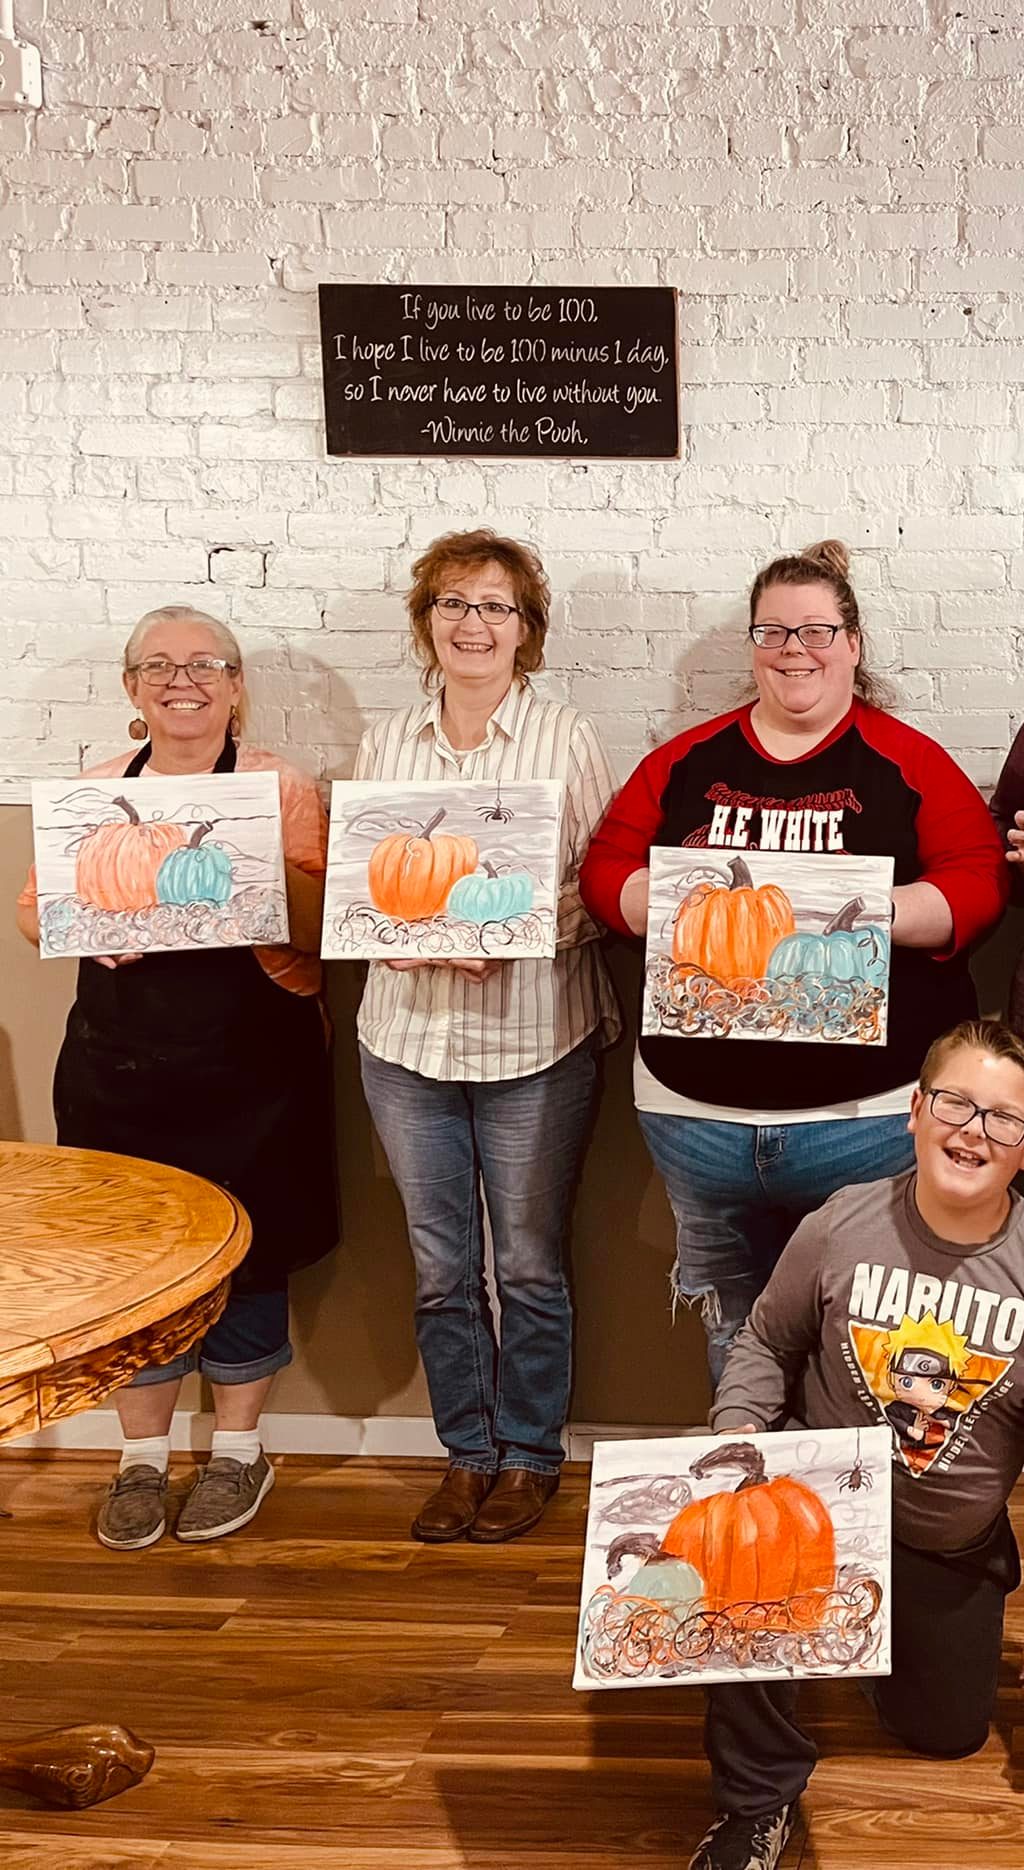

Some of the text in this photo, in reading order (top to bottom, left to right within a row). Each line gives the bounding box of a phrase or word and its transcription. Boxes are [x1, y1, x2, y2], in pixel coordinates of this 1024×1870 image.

[400, 293, 599, 330] If you live to be 100,
[333, 334, 670, 373] I hope I live to be 100 minus 1 day,
[344, 383, 364, 400] so
[368, 375, 383, 401] I
[388, 384, 438, 402] never
[443, 376, 487, 403] have
[492, 383, 511, 403] to
[516, 378, 547, 403] live
[553, 379, 620, 404] without
[500, 418, 531, 443] the
[534, 416, 589, 444] Pooh,
[759, 808, 844, 852] WHITE
